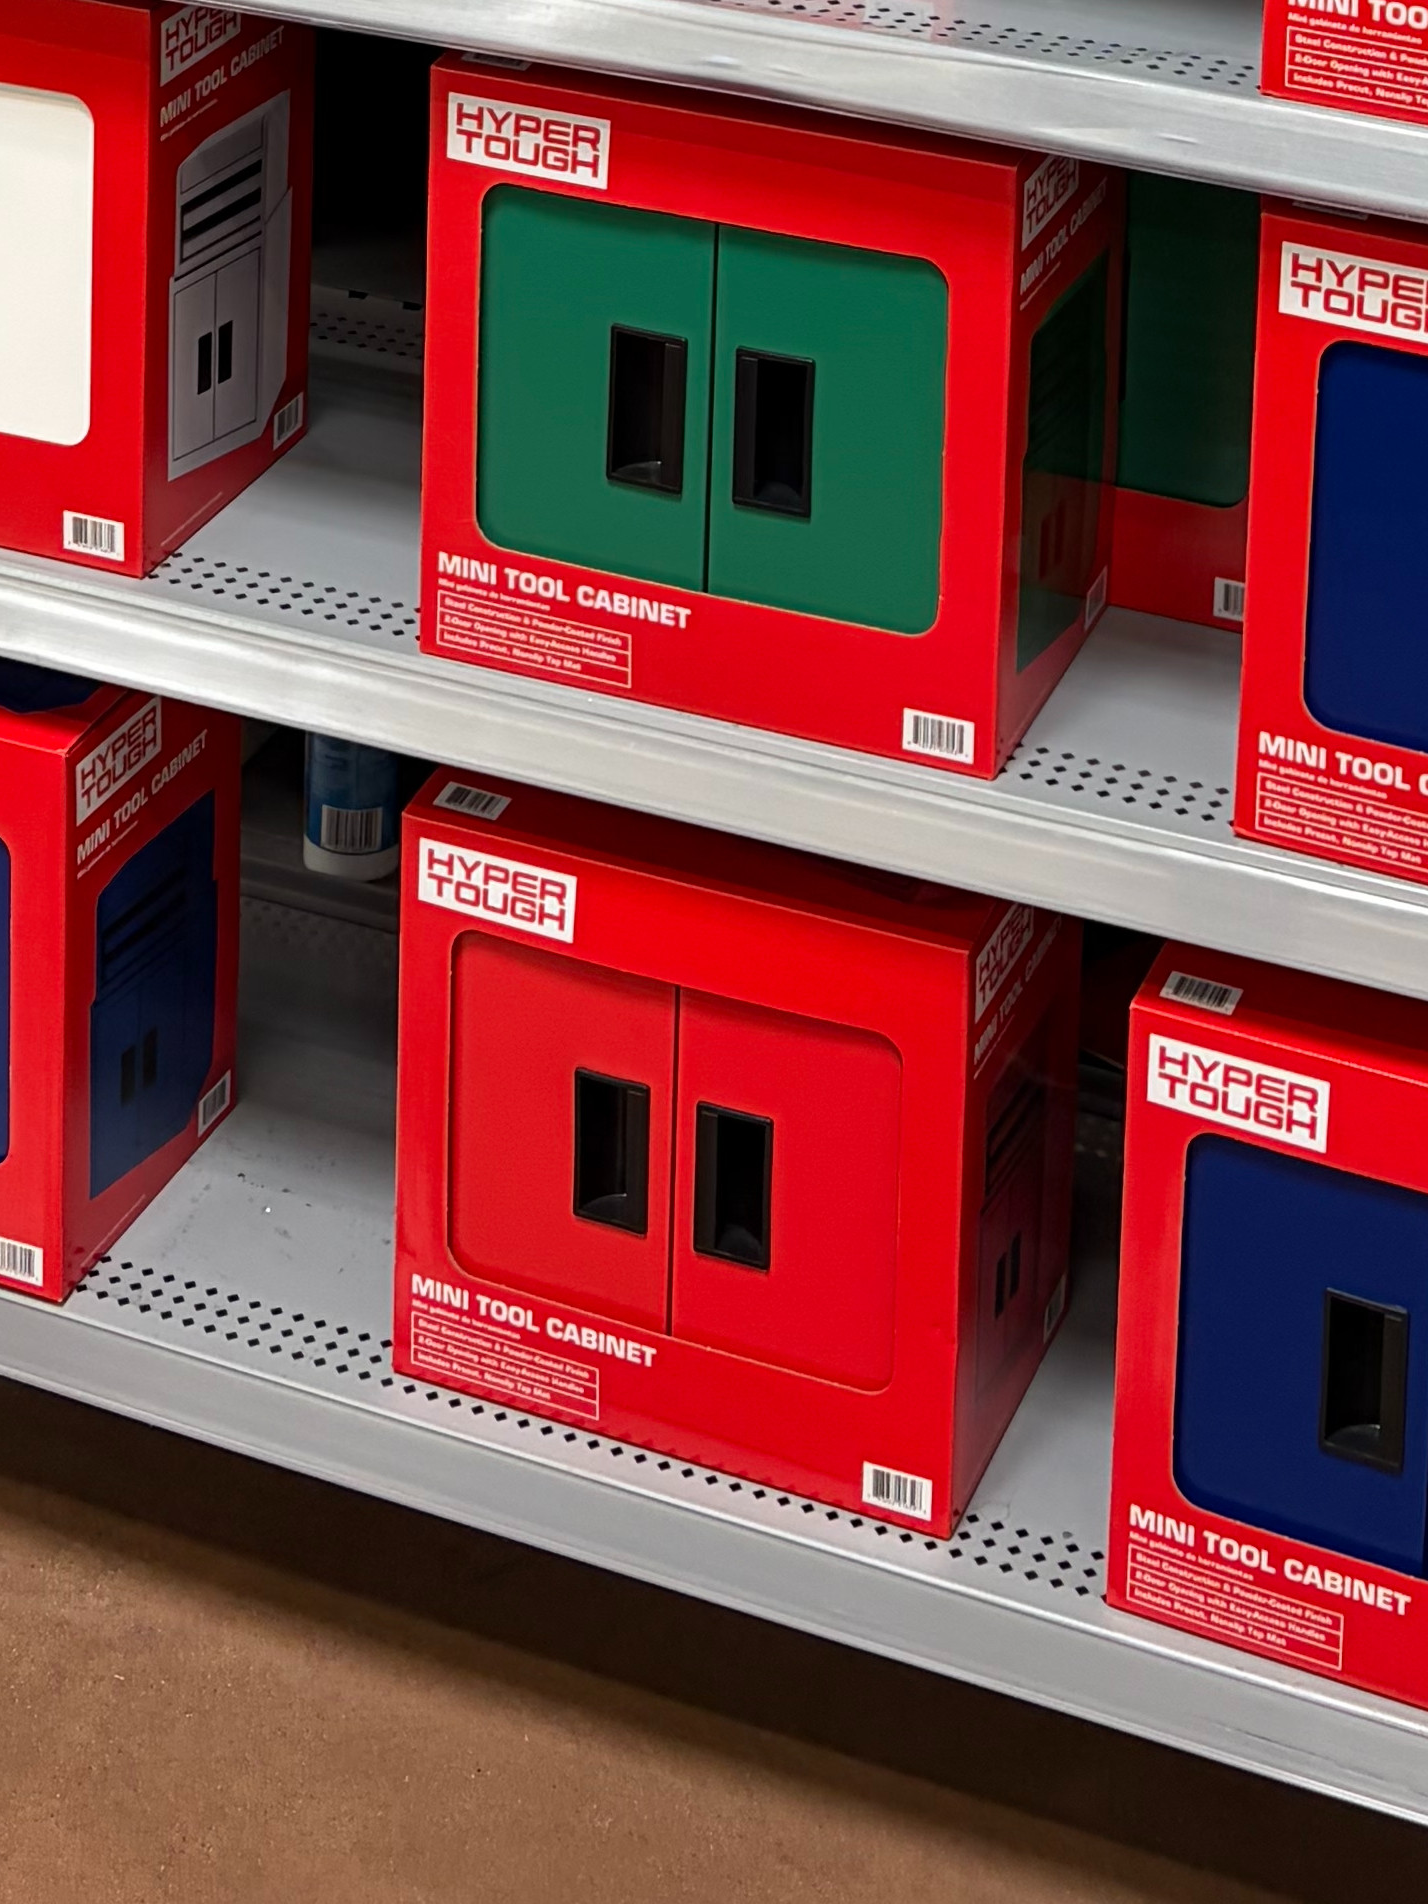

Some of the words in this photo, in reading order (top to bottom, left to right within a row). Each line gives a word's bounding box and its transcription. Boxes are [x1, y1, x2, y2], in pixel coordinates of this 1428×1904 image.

[1323, 36, 1387, 59] Construction
[1389, 50, 1398, 61] &
[1349, 23, 1360, 33] de
[1293, 71, 1334, 89] Includes
[1375, 86, 1413, 104] Nonslip
[1294, 53, 1328, 68] 2-Door
[1330, 56, 1370, 78] Opening
[1372, 66, 1394, 81] with
[455, 126, 599, 180] TOUGH
[456, 102, 600, 154] HYPER
[438, 551, 496, 586] MINI
[504, 567, 570, 603] TOOL
[577, 585, 691, 629] CABINET
[1259, 731, 1326, 770] MINI
[1335, 751, 1410, 791] TOOL
[426, 871, 567, 933] TOUGH
[427, 847, 568, 909] HYPER
[1157, 1070, 1319, 1142] TOUGH
[1158, 1044, 1321, 1116] HYPER
[412, 1273, 469, 1311] MINI
[476, 1293, 540, 1333] TOOL
[547, 1317, 656, 1367] CABINET
[1130, 1503, 1195, 1547] MINI
[1203, 1530, 1276, 1574] TOOL
[1284, 1558, 1411, 1616] CABINET
